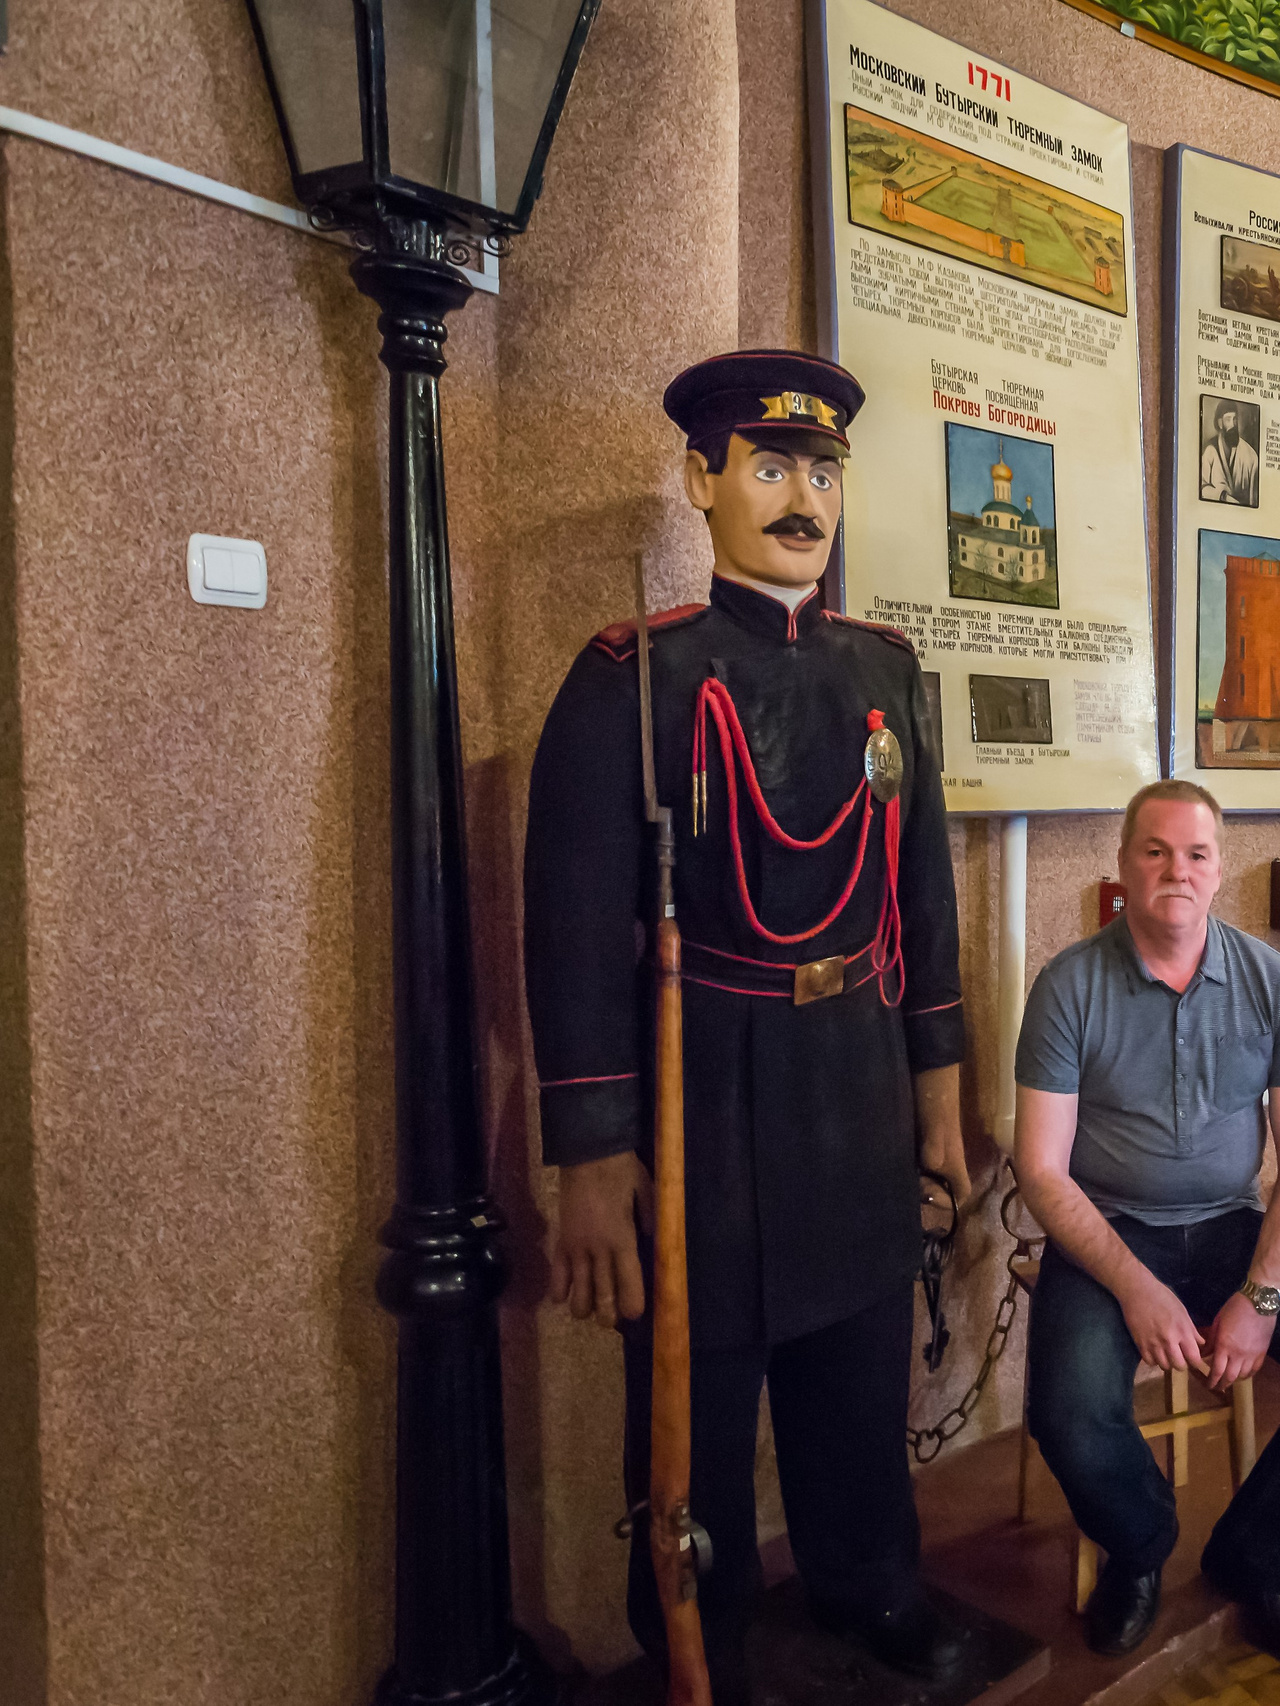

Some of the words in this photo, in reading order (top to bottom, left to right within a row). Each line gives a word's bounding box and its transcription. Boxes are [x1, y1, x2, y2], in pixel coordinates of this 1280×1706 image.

[967, 60, 1011, 102] 1771
[850, 44, 926, 97] МОСКОВСКИЙ
[936, 82, 999, 128] БУТЫРСКИЙ
[1007, 113, 1063, 156] ТЮРЕМНЫЙ
[1071, 145, 1103, 173] ЗАМОК
[1194, 211, 1233, 232] ВСПЫХИВАЛИ
[931, 358, 979, 385] БУТЫРСКАЯ
[932, 375, 966, 395] ЦЕРКОВЬ
[1003, 379, 1045, 402] ТЮРЕМНАЯ
[933, 389, 981, 418] ПОКРОВУ
[985, 388, 1039, 413] ПОСВЯЩЕННАЯ
[988, 404, 1056, 437] БОГОРОДИЦЫ
[916, 615, 926, 625] НА
[932, 616, 960, 628] ВТОРОМ
[966, 620, 991, 631] ЭТАЖЕ
[998, 623, 1053, 637] ВМЕСТИТЕЛЬНЫХ
[940, 605, 991, 621] ОСОБЕННОСТЬЮ
[1040, 616, 1063, 628] ЦЕРКВИ
[1067, 619, 1084, 630] БЫЛО
[932, 640, 956, 651] КАМЕР
[967, 632, 1005, 644] ТЮРЕМНЫХ
[1056, 640, 1068, 650] ЭТИ
[962, 778, 982, 788] БАШНЯ
